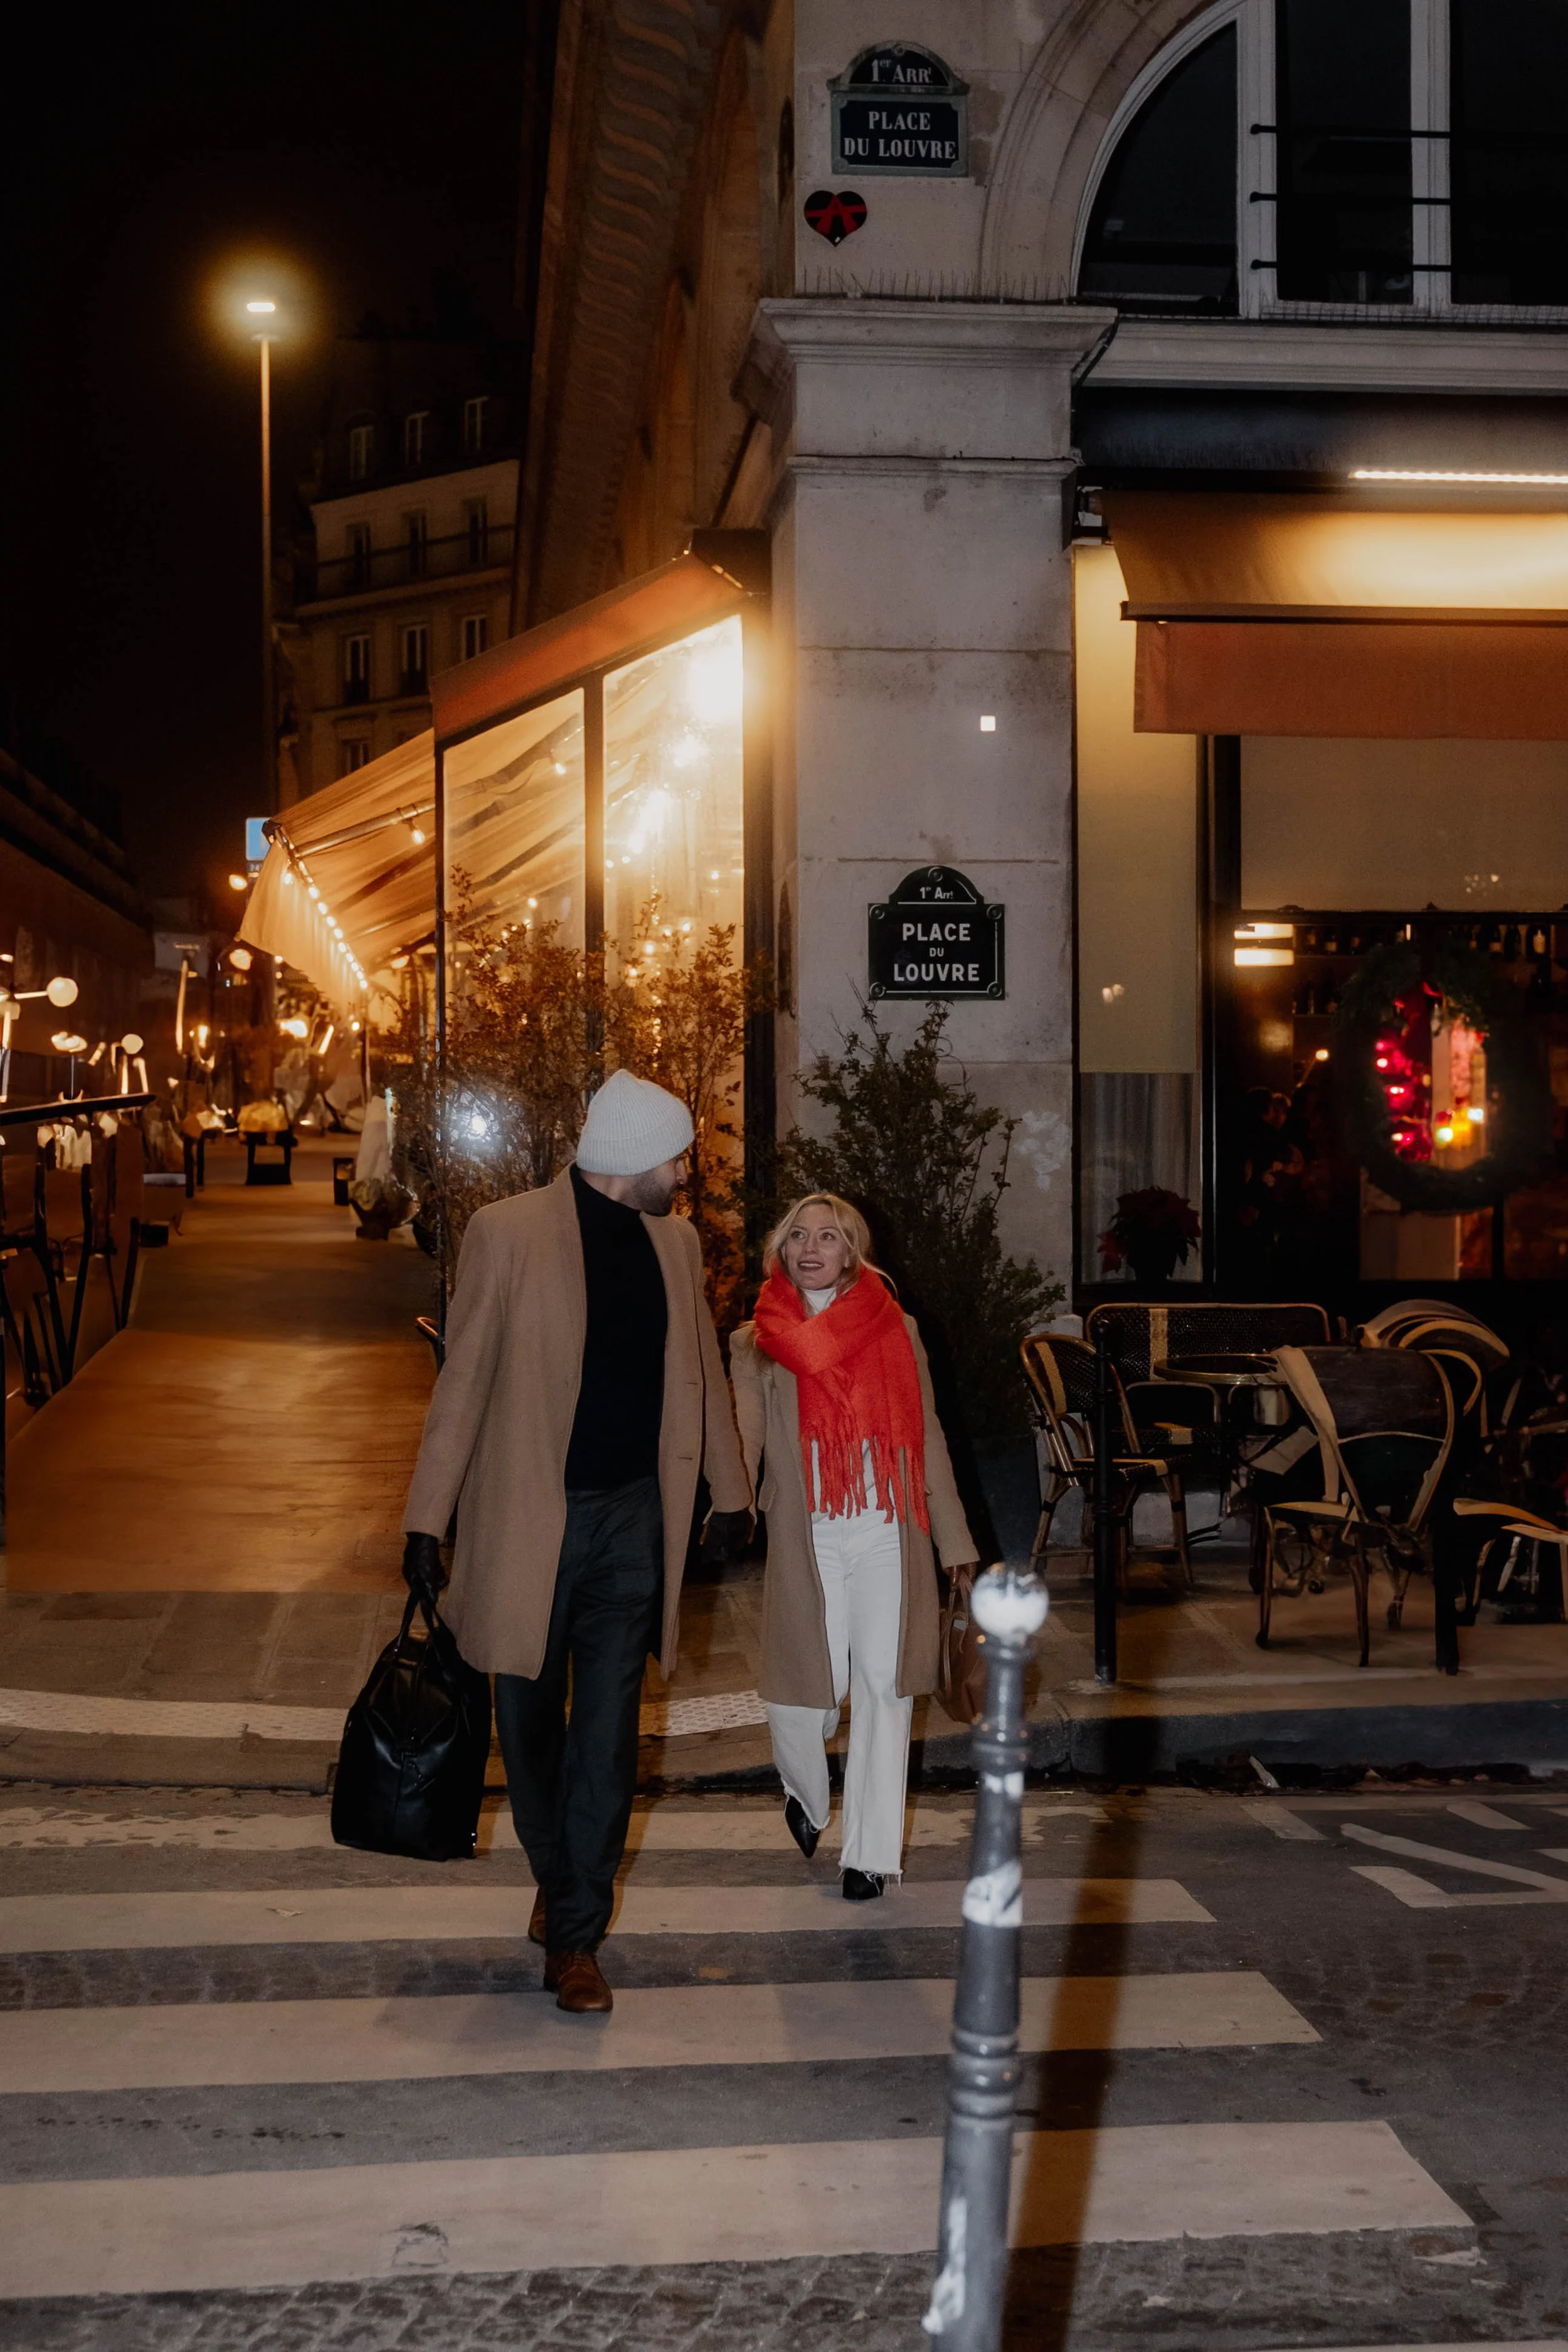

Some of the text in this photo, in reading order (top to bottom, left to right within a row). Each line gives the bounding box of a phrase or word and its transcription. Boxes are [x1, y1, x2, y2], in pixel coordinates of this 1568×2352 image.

[868, 111, 931, 130] PLACE
[844, 137, 956, 159] DU LOUVRE
[902, 923, 971, 941] PLACE
[929, 947, 945, 957] DU
[893, 963, 980, 982] LOUVRE
